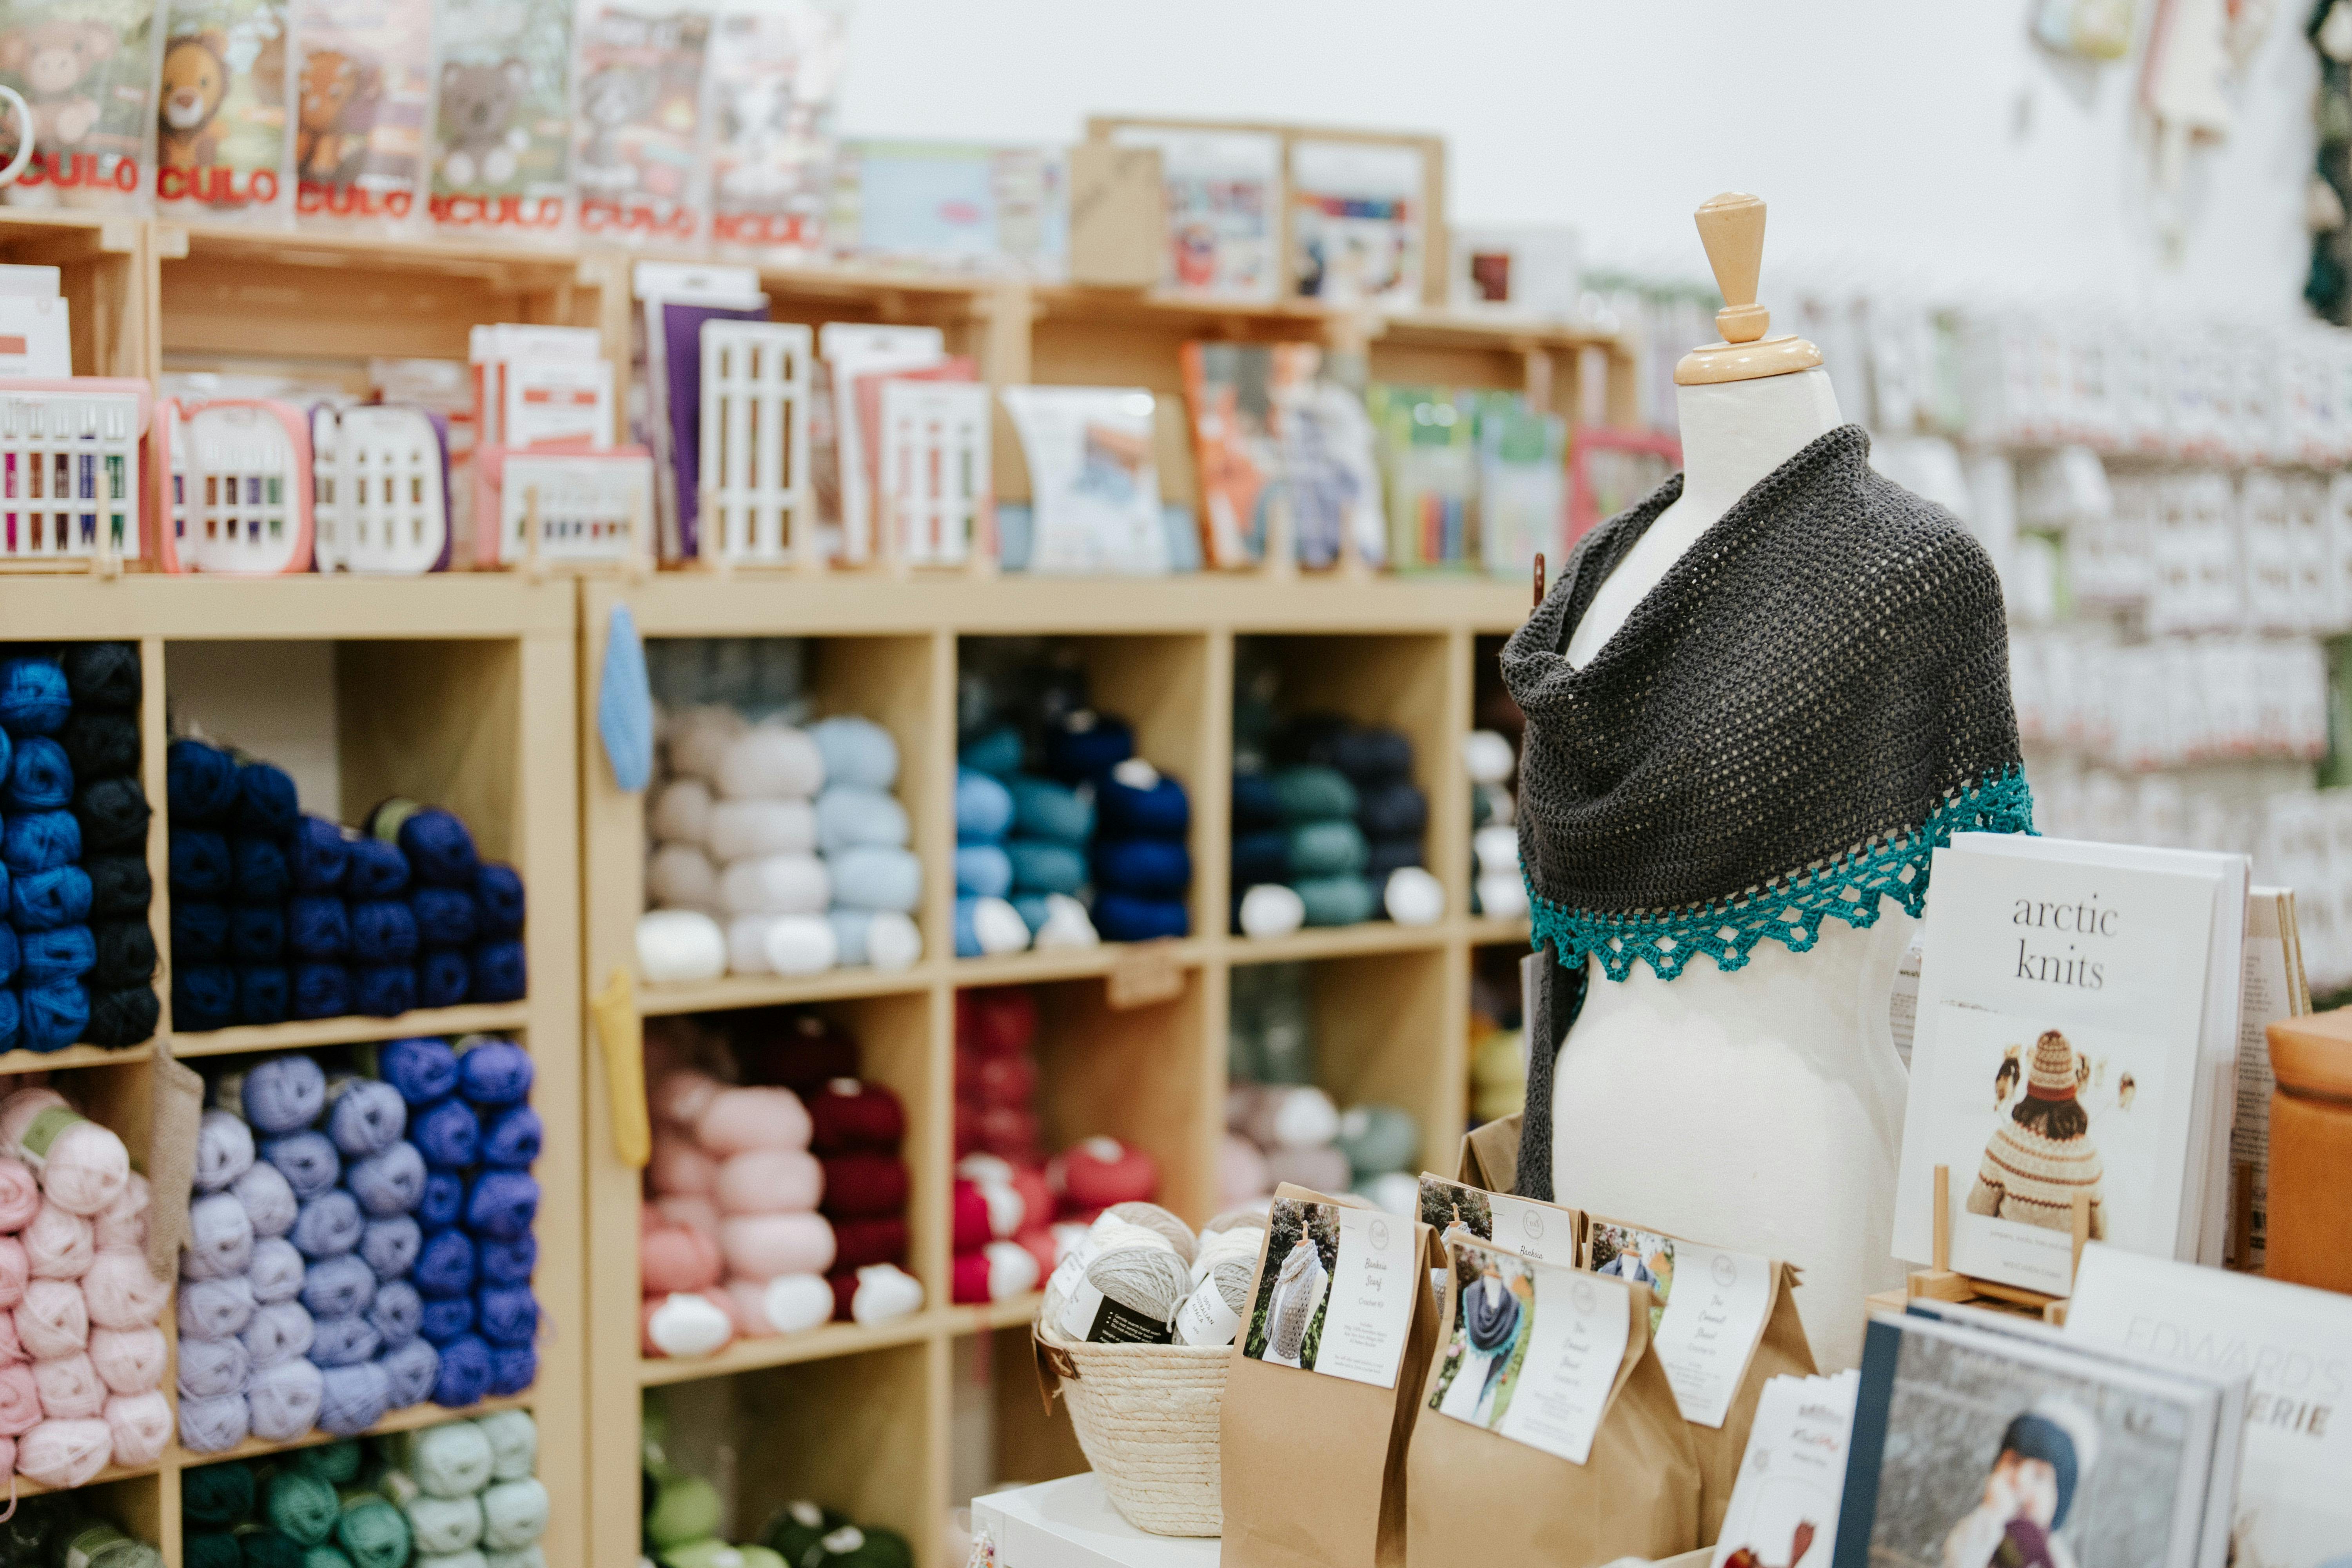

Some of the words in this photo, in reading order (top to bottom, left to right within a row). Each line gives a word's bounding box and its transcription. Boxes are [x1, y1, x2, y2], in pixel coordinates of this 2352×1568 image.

[0, 152, 138, 193] CULO
[2013, 893, 2118, 937] arctic
[2016, 938, 2104, 989] knits
[1520, 1245, 1543, 1259] Banksia
